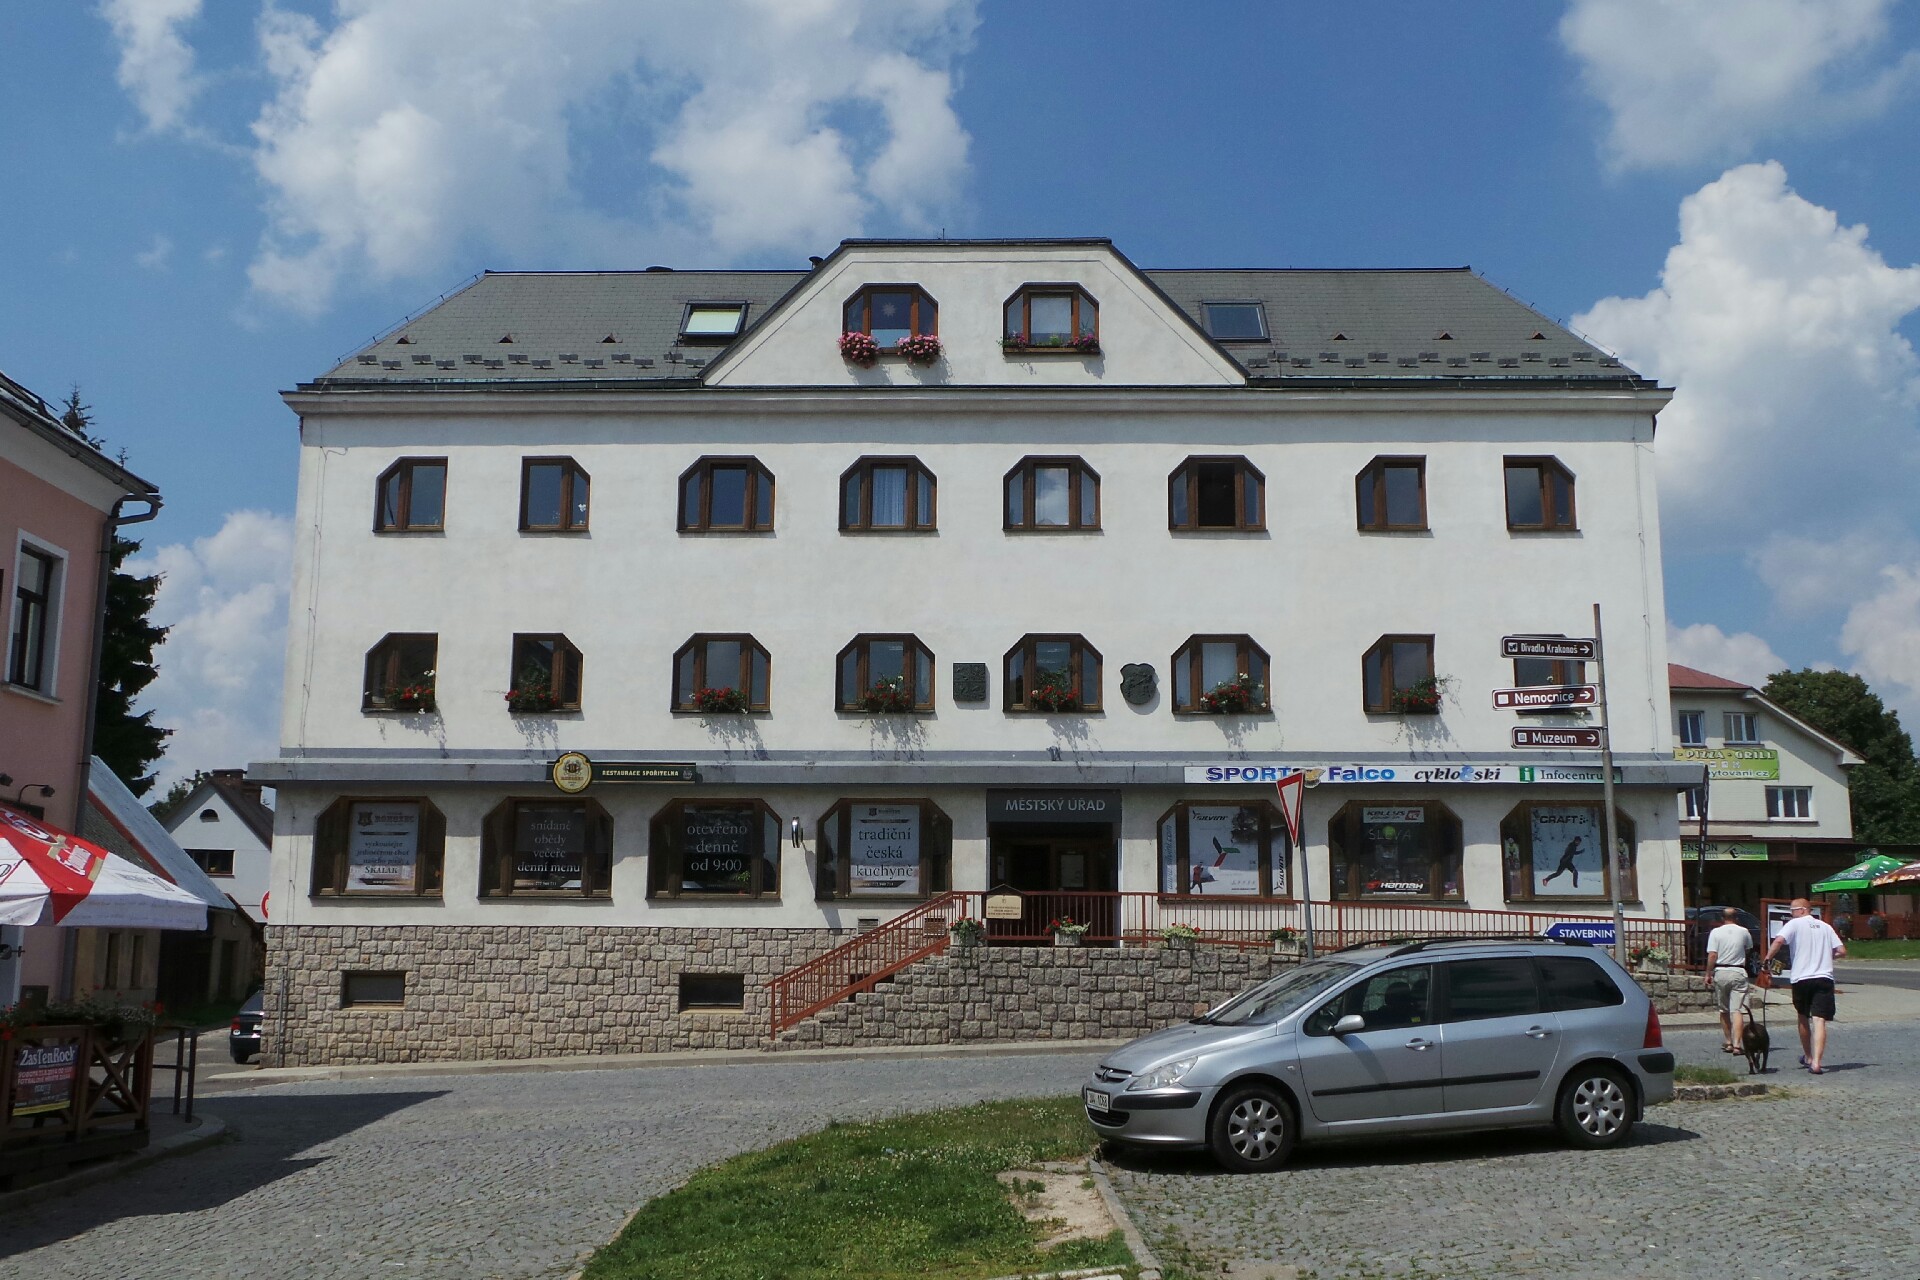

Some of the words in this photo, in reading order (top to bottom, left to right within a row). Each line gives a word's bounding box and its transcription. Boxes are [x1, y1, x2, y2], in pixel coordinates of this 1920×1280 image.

[1520, 642, 1545, 653] Divadlo
[1546, 644, 1578, 654] Krakonoš
[1514, 691, 1575, 704] Nemocnice
[1532, 732, 1577, 744] Muzeum
[1685, 750, 1725, 759] PIZZA
[1735, 751, 1776, 760] GRILL
[642, 768, 679, 777] SPOŘITELNA
[1328, 766, 1396, 781] Falco
[1540, 769, 1616, 780] Infocentru
[1005, 797, 1065, 811] MĚSTSKÝ
[1068, 797, 1106, 811] ÚŘAD
[1540, 815, 1577, 824] CRAFT
[687, 822, 748, 835] otevřeno
[858, 827, 911, 840] tradiční
[1368, 828, 1412, 840] SLVA
[534, 834, 566, 847] obědy
[696, 839, 739, 853] denně
[533, 848, 566, 858] večeře
[866, 845, 903, 859] česká
[517, 861, 548, 872] denní
[550, 863, 580, 872] menu
[691, 858, 709, 871] od
[713, 859, 742, 871] 9:00
[856, 864, 914, 880] kuchyně
